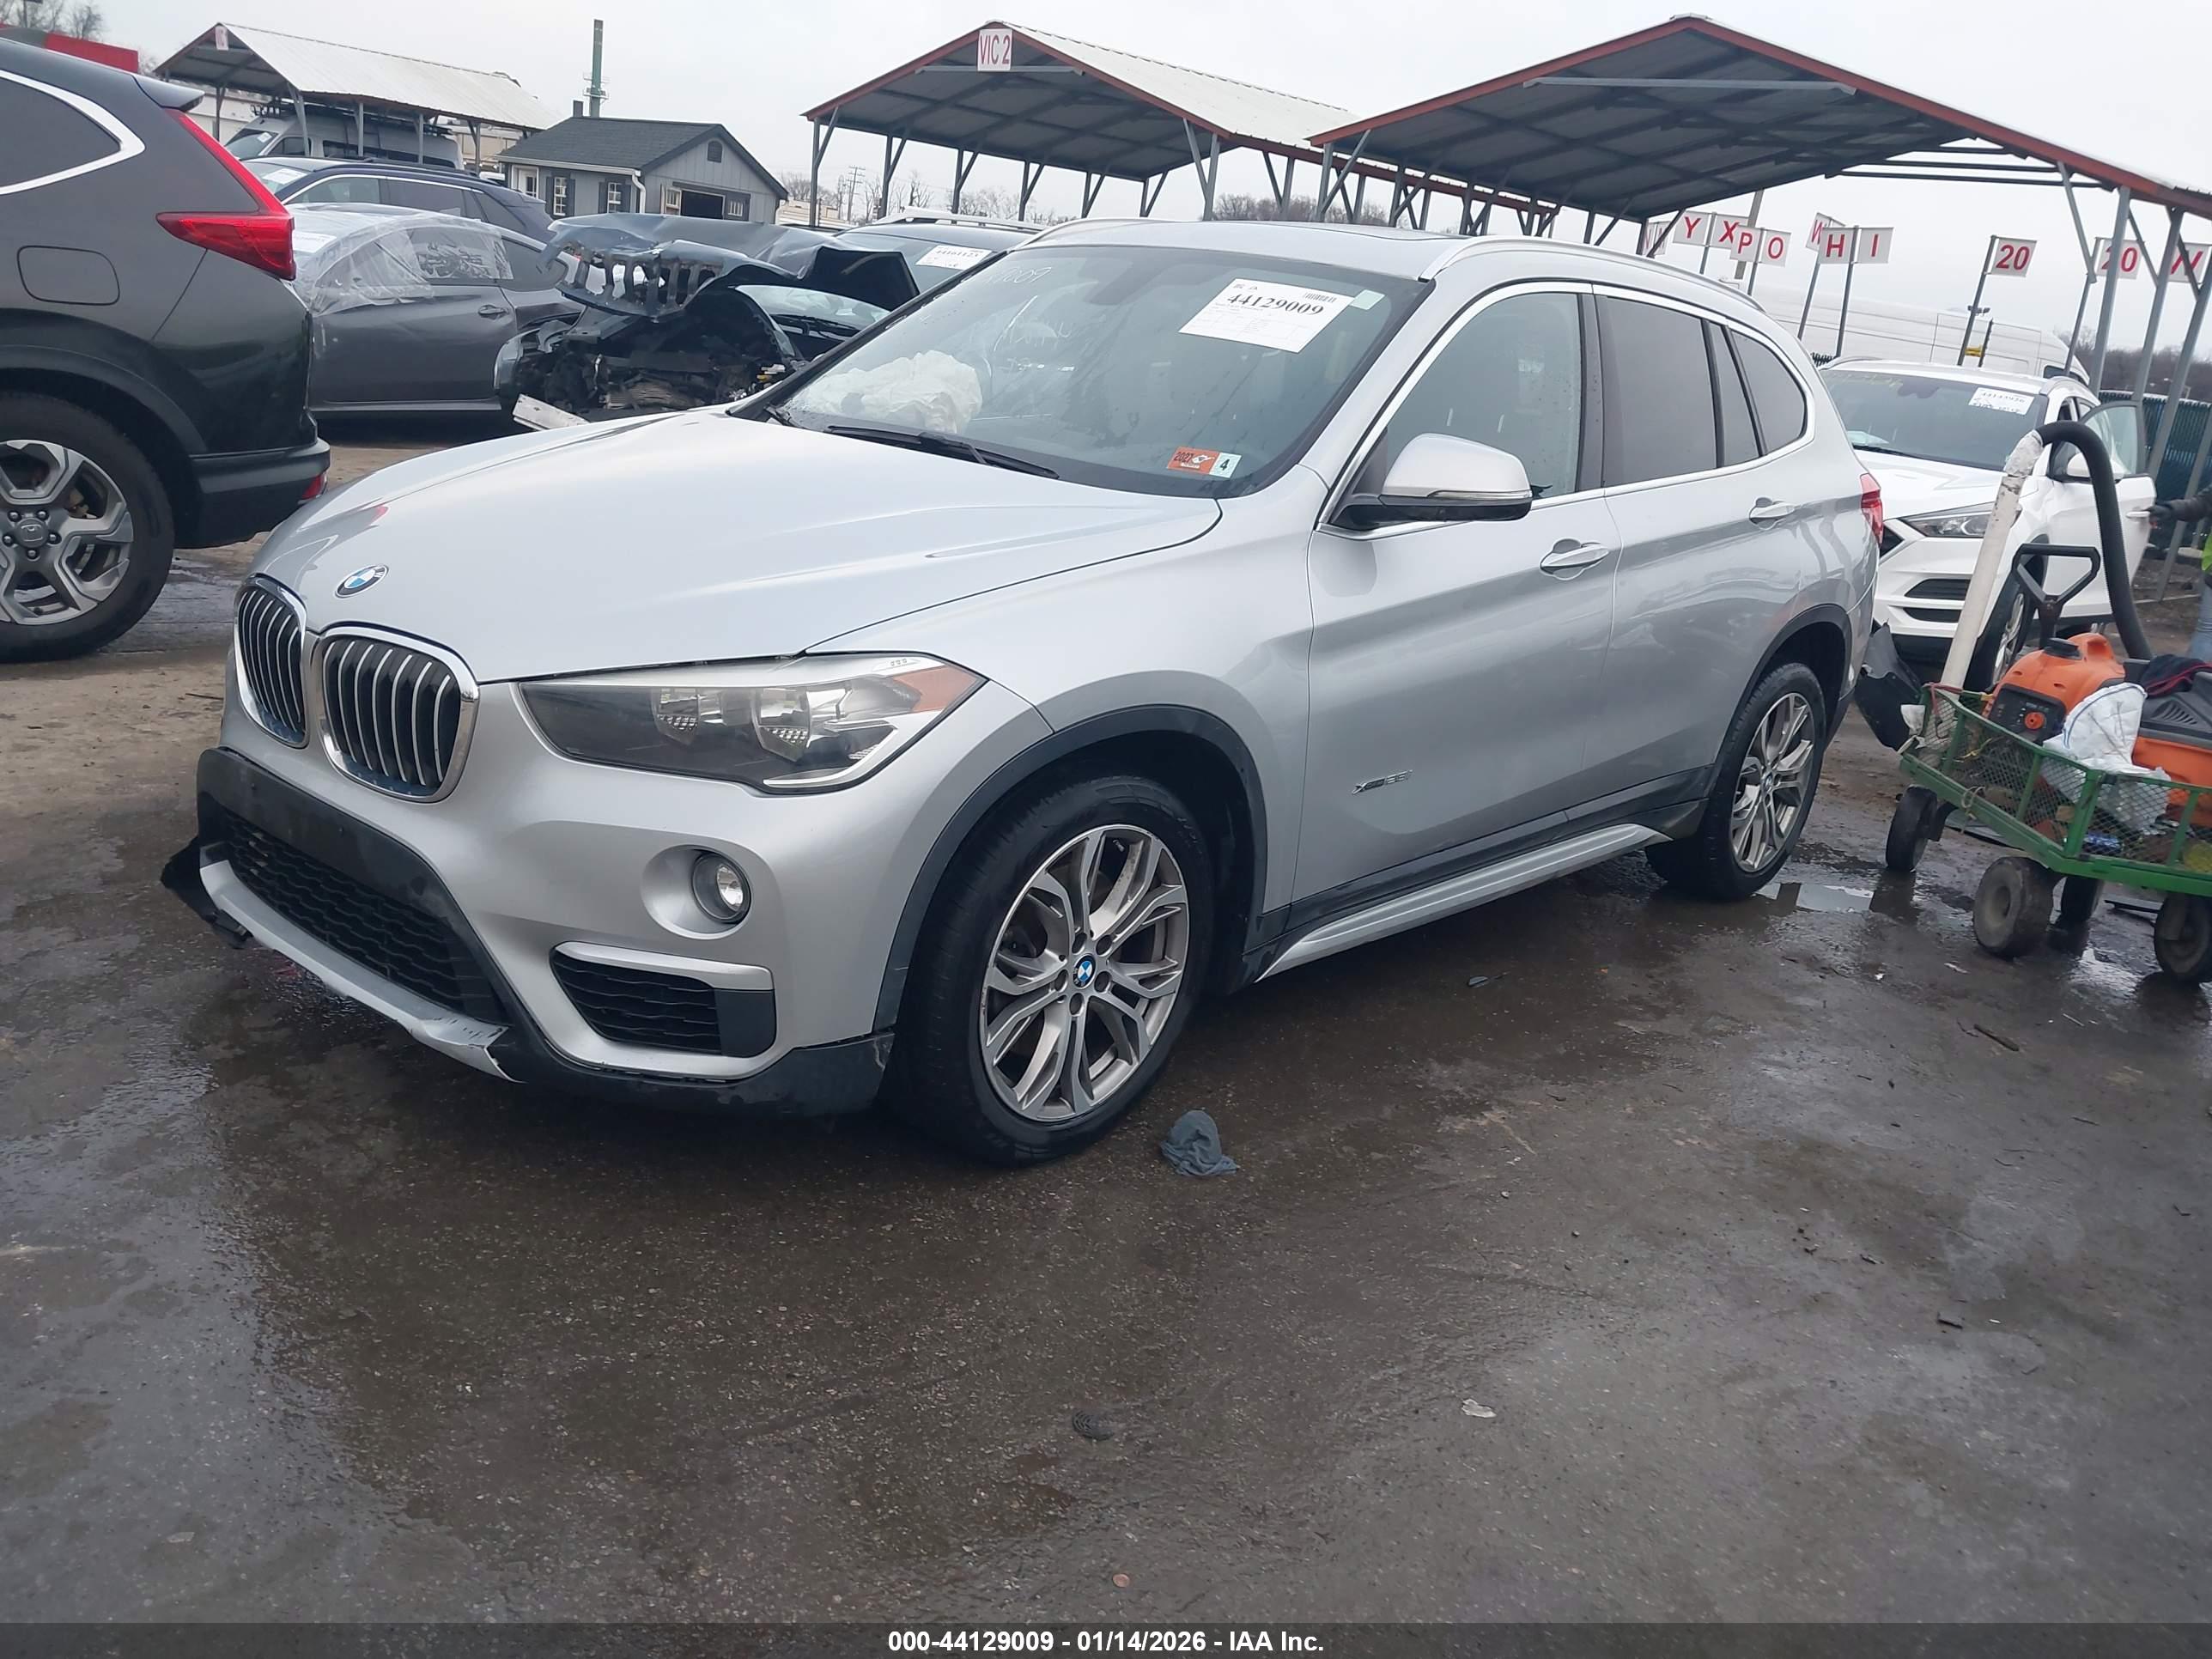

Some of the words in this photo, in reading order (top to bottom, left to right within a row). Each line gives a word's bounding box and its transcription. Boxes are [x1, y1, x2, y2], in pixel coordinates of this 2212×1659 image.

[980, 34, 1000, 64] VIC
[1002, 34, 1010, 64] 2
[1684, 216, 1701, 239] Y
[1719, 221, 1739, 243] X
[1737, 232, 1753, 254] P
[1826, 234, 1845, 258] H
[1870, 234, 1879, 257] I
[1996, 245, 2030, 270] 20
[1227, 293, 1325, 316] 44129009
[1220, 459, 1231, 471] 4
